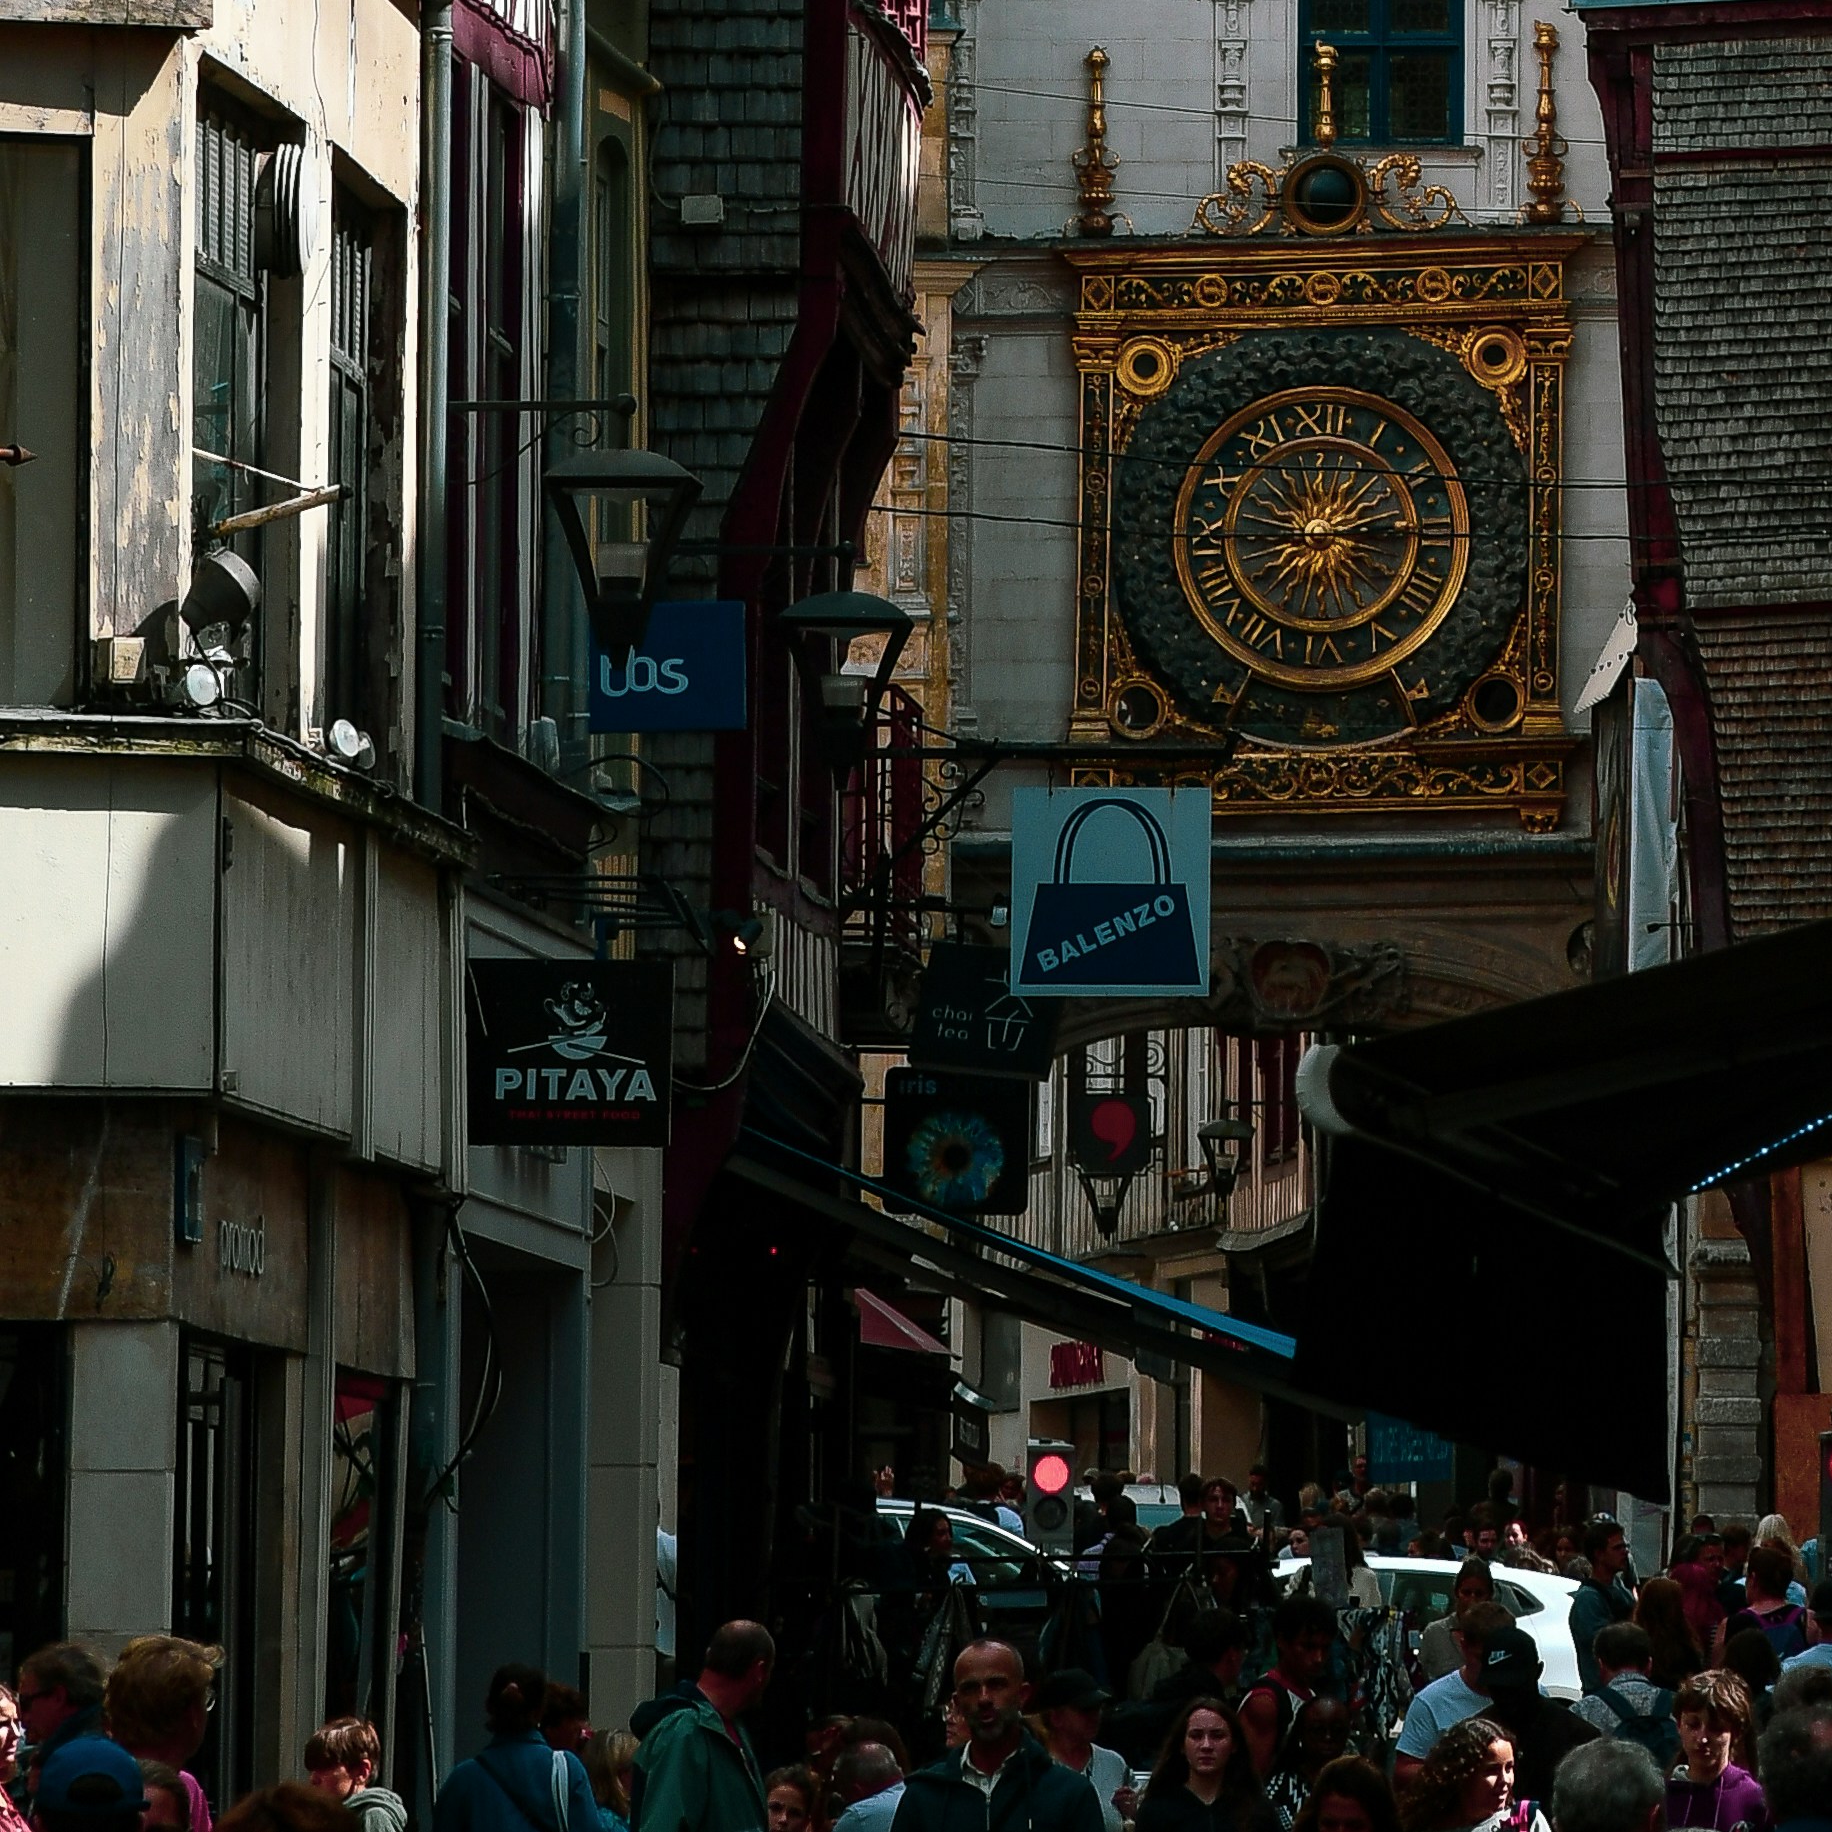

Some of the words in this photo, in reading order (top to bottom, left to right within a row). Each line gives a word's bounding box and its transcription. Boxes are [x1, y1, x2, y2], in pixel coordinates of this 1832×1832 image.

[1293, 404, 1345, 435] XII
[1037, 895, 1175, 972] BALENZO
[932, 1005, 973, 1021] chai
[937, 1023, 968, 1040] tea
[495, 1068, 657, 1102] PITAYA
